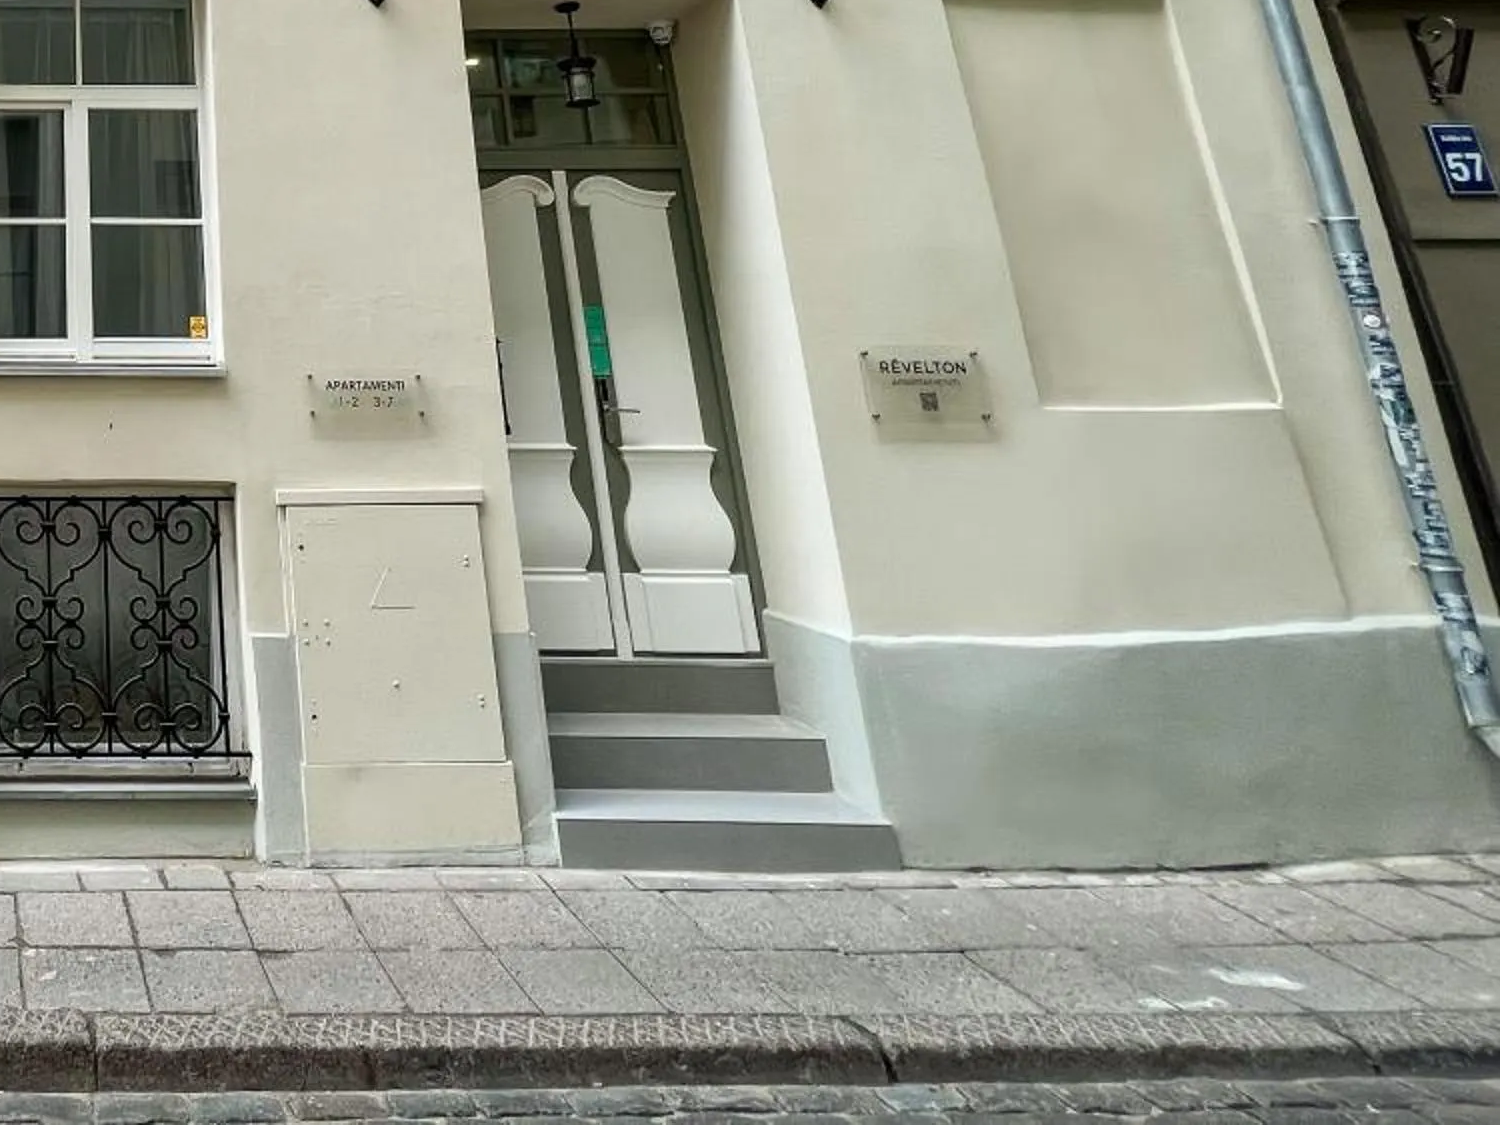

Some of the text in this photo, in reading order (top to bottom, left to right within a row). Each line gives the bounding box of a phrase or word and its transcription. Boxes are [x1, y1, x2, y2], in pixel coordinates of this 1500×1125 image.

[1445, 152, 1484, 182] 57
[879, 358, 967, 375] RÊVELTON
[325, 380, 405, 391] APARTAMENTI
